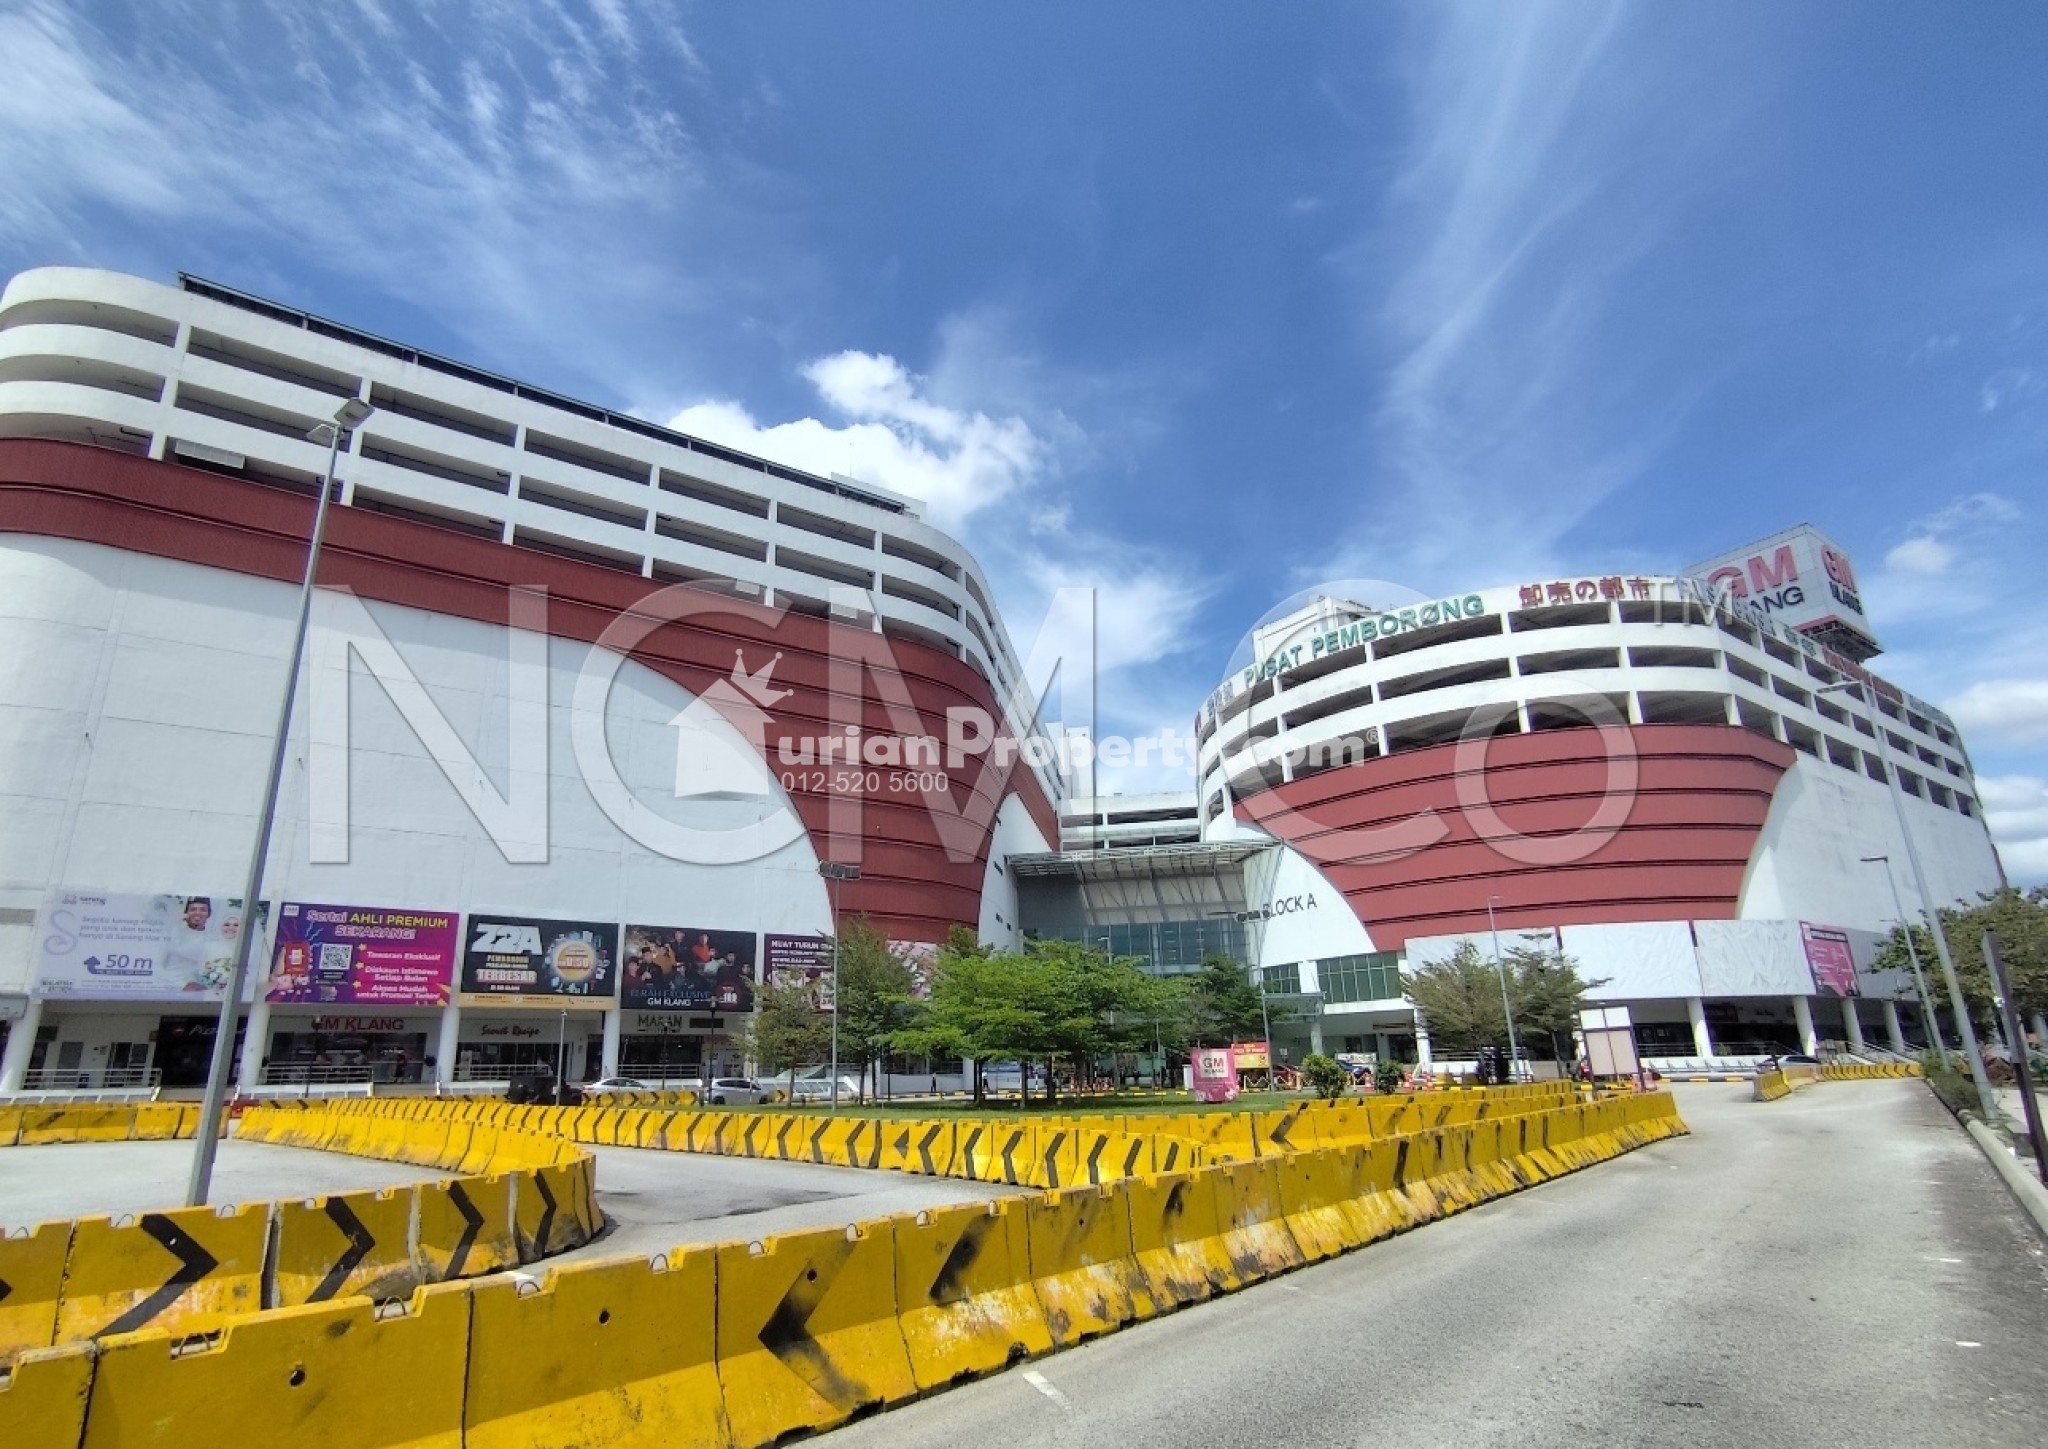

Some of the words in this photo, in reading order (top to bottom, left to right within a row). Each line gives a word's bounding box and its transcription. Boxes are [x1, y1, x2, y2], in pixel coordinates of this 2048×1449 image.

[1707, 544, 1798, 597] GM
[1244, 644, 1303, 688] PUSAT
[1307, 892, 1318, 910] A
[350, 913, 382, 924] AHLI
[386, 916, 448, 928] PREMIUM
[106, 954, 130, 968] 50
[134, 958, 152, 968] m
[476, 969, 538, 984] TERBESAR
[648, 998, 661, 1006] GM
[664, 998, 692, 1006] KLANG
[345, 1018, 404, 1031] KLANG
[1204, 1058, 1224, 1068] GM
